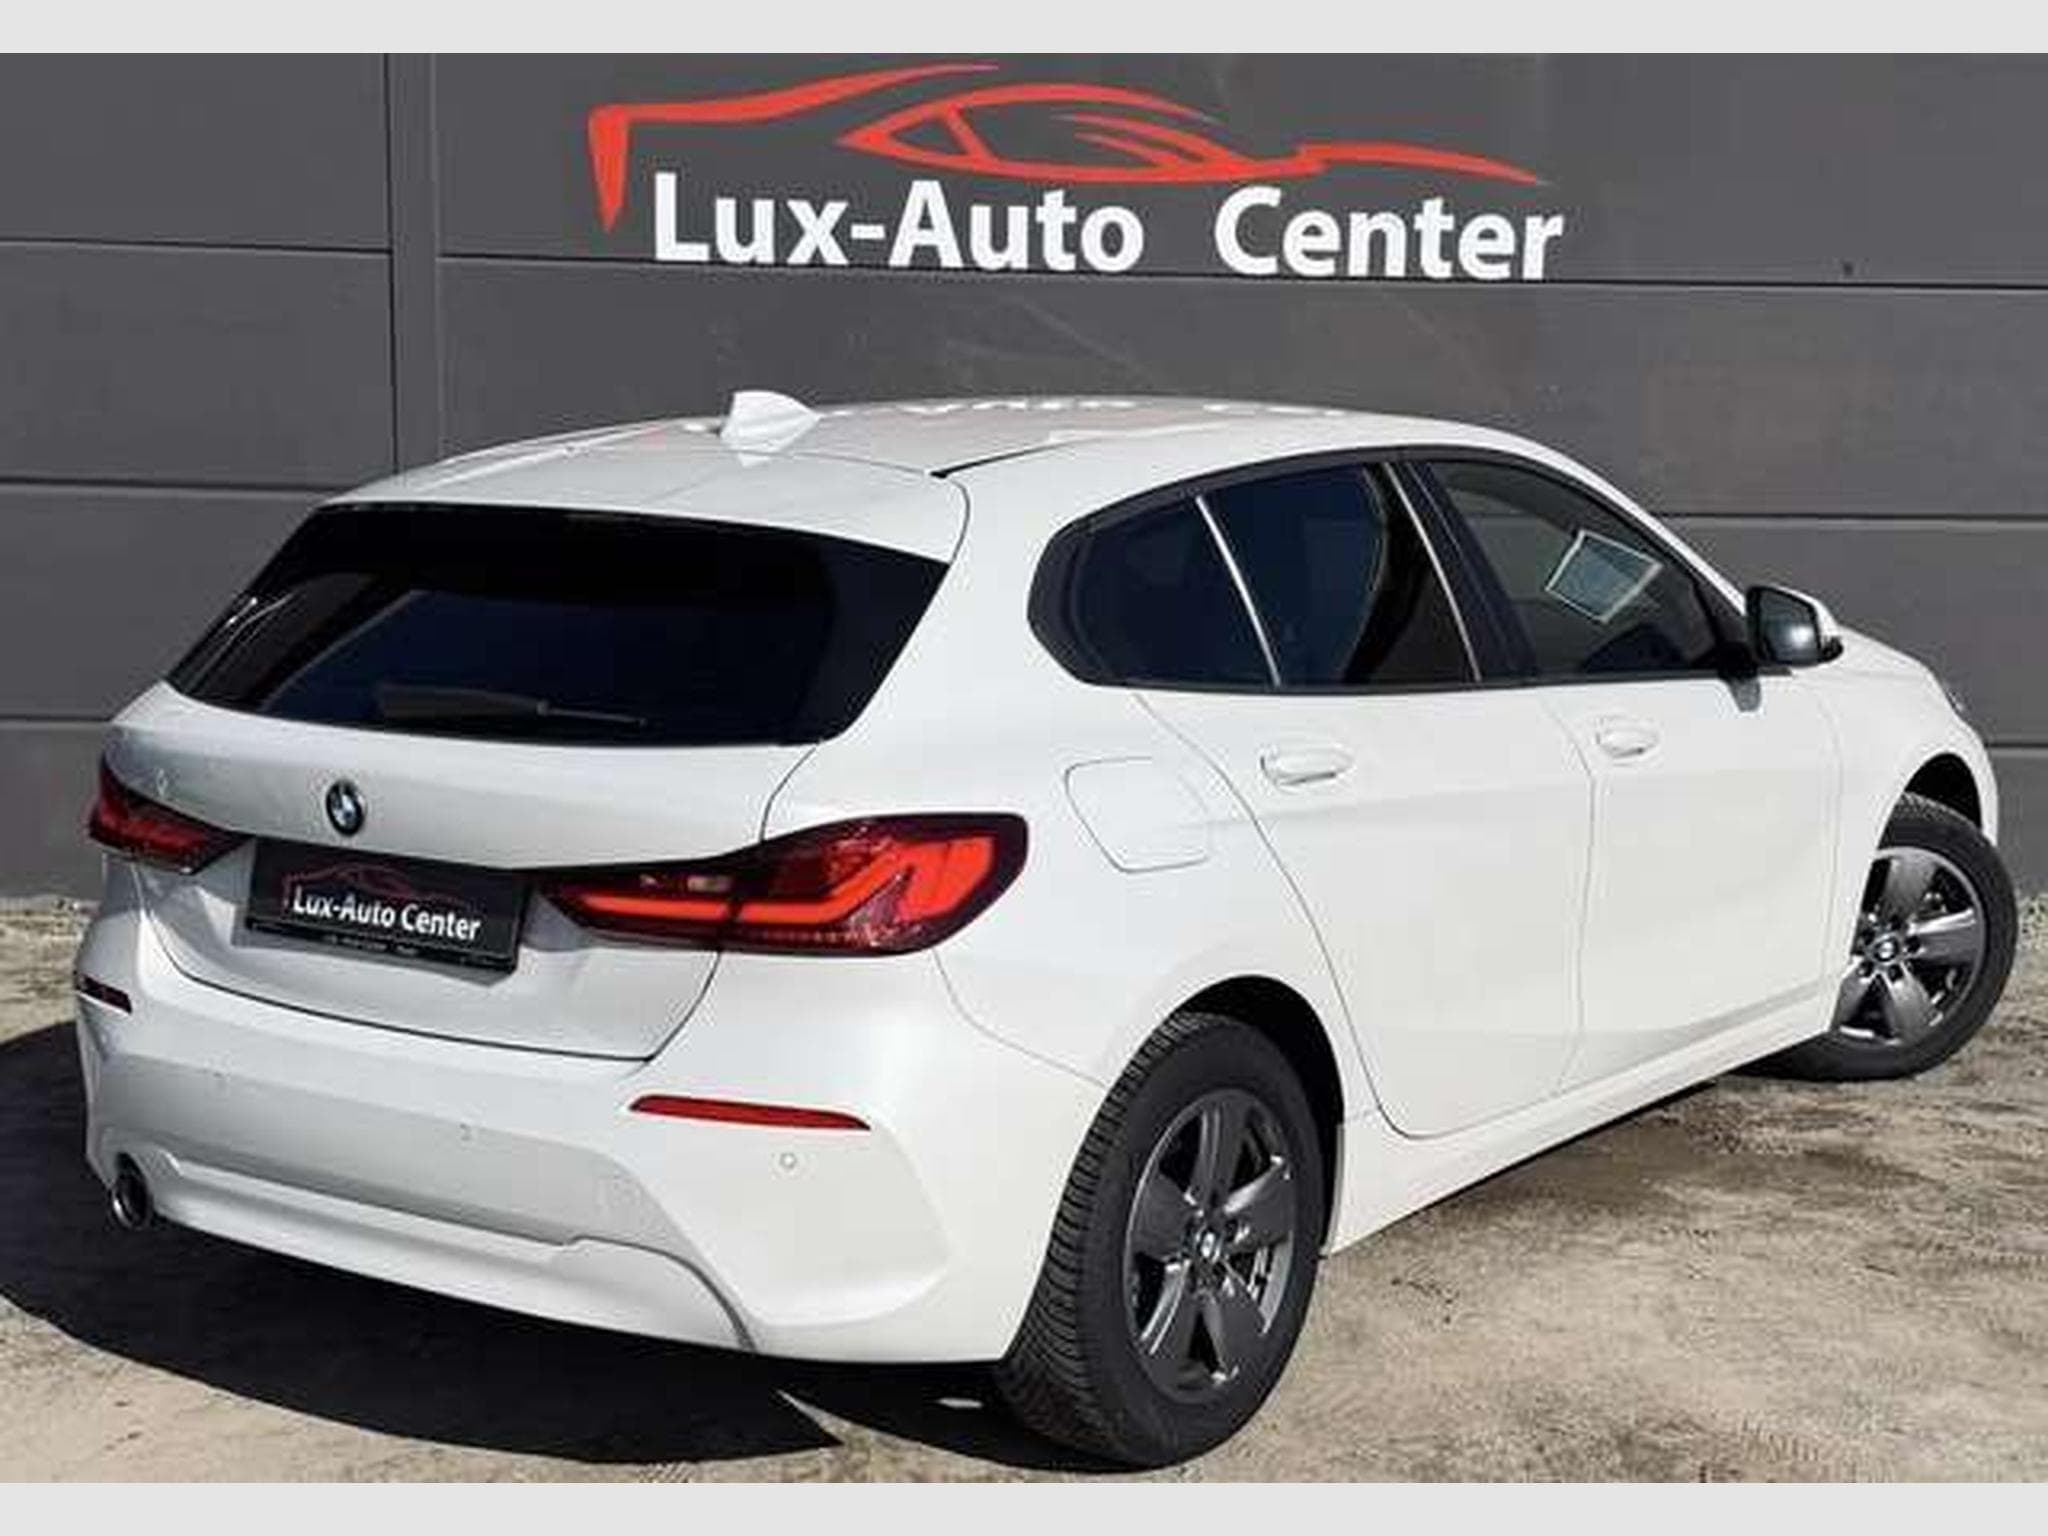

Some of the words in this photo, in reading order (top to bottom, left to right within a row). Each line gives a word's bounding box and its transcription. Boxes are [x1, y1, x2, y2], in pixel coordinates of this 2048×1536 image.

[655, 172, 1143, 271] Lux-Auto
[1215, 186, 1564, 279] Center
[292, 885, 396, 928] Lux-Auto
[401, 904, 480, 940] Center
